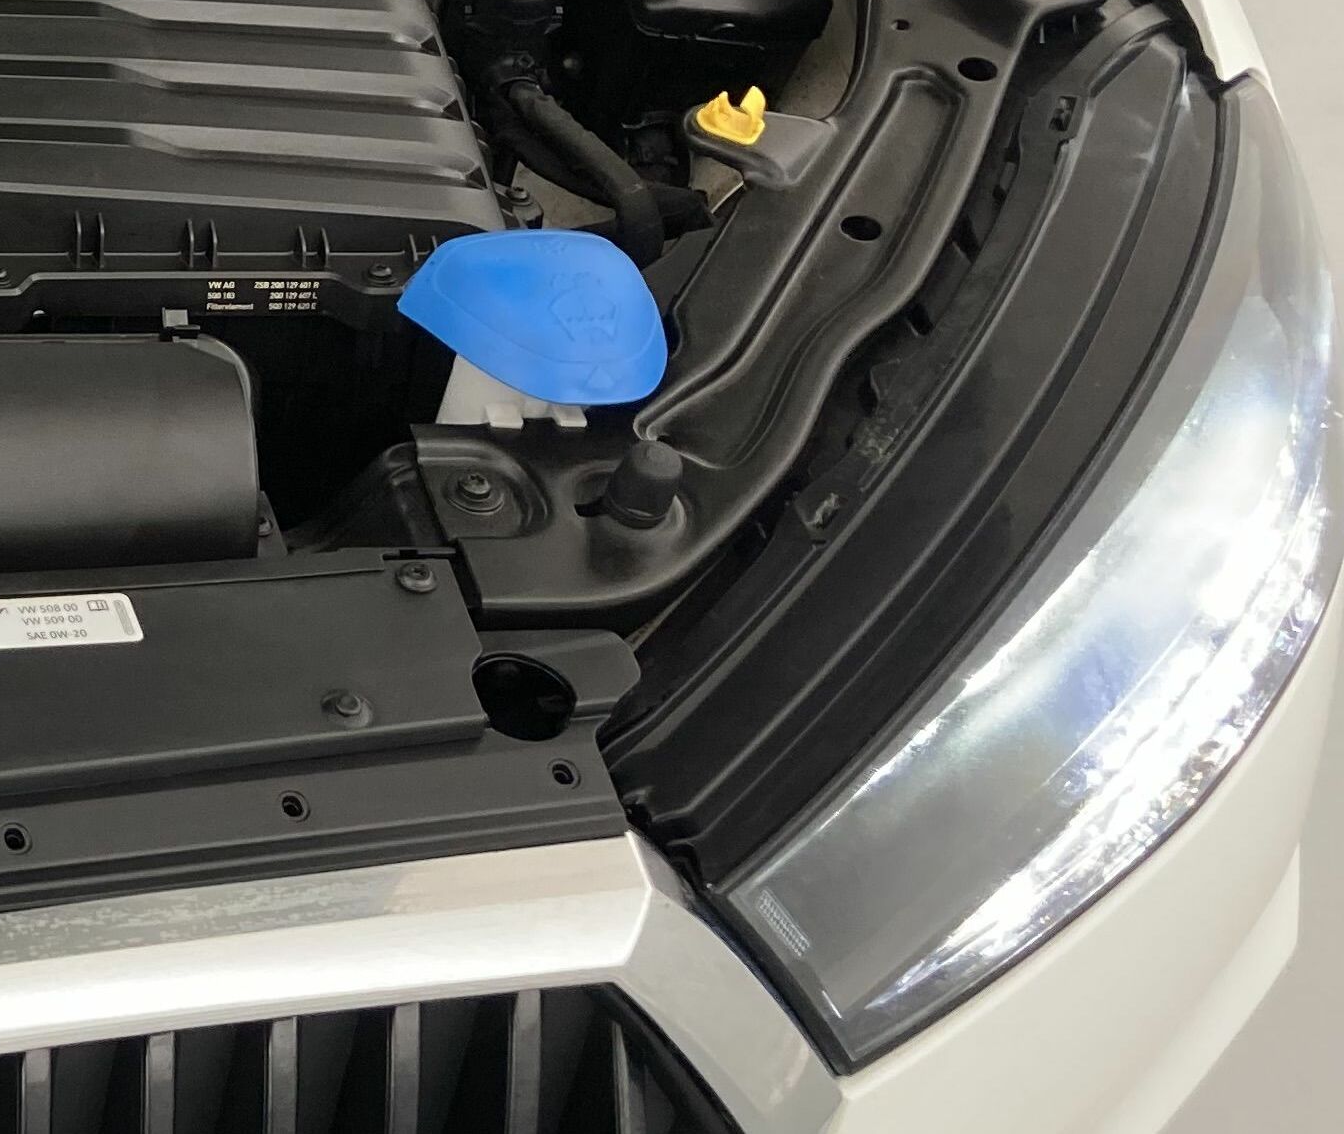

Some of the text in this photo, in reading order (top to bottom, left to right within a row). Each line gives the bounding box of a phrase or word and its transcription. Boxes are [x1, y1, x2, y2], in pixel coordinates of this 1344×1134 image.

[208, 281, 222, 289] VW
[17, 603, 79, 614] VW 508 00
[22, 614, 84, 626] VW 509 00
[26, 631, 48, 641] SAE
